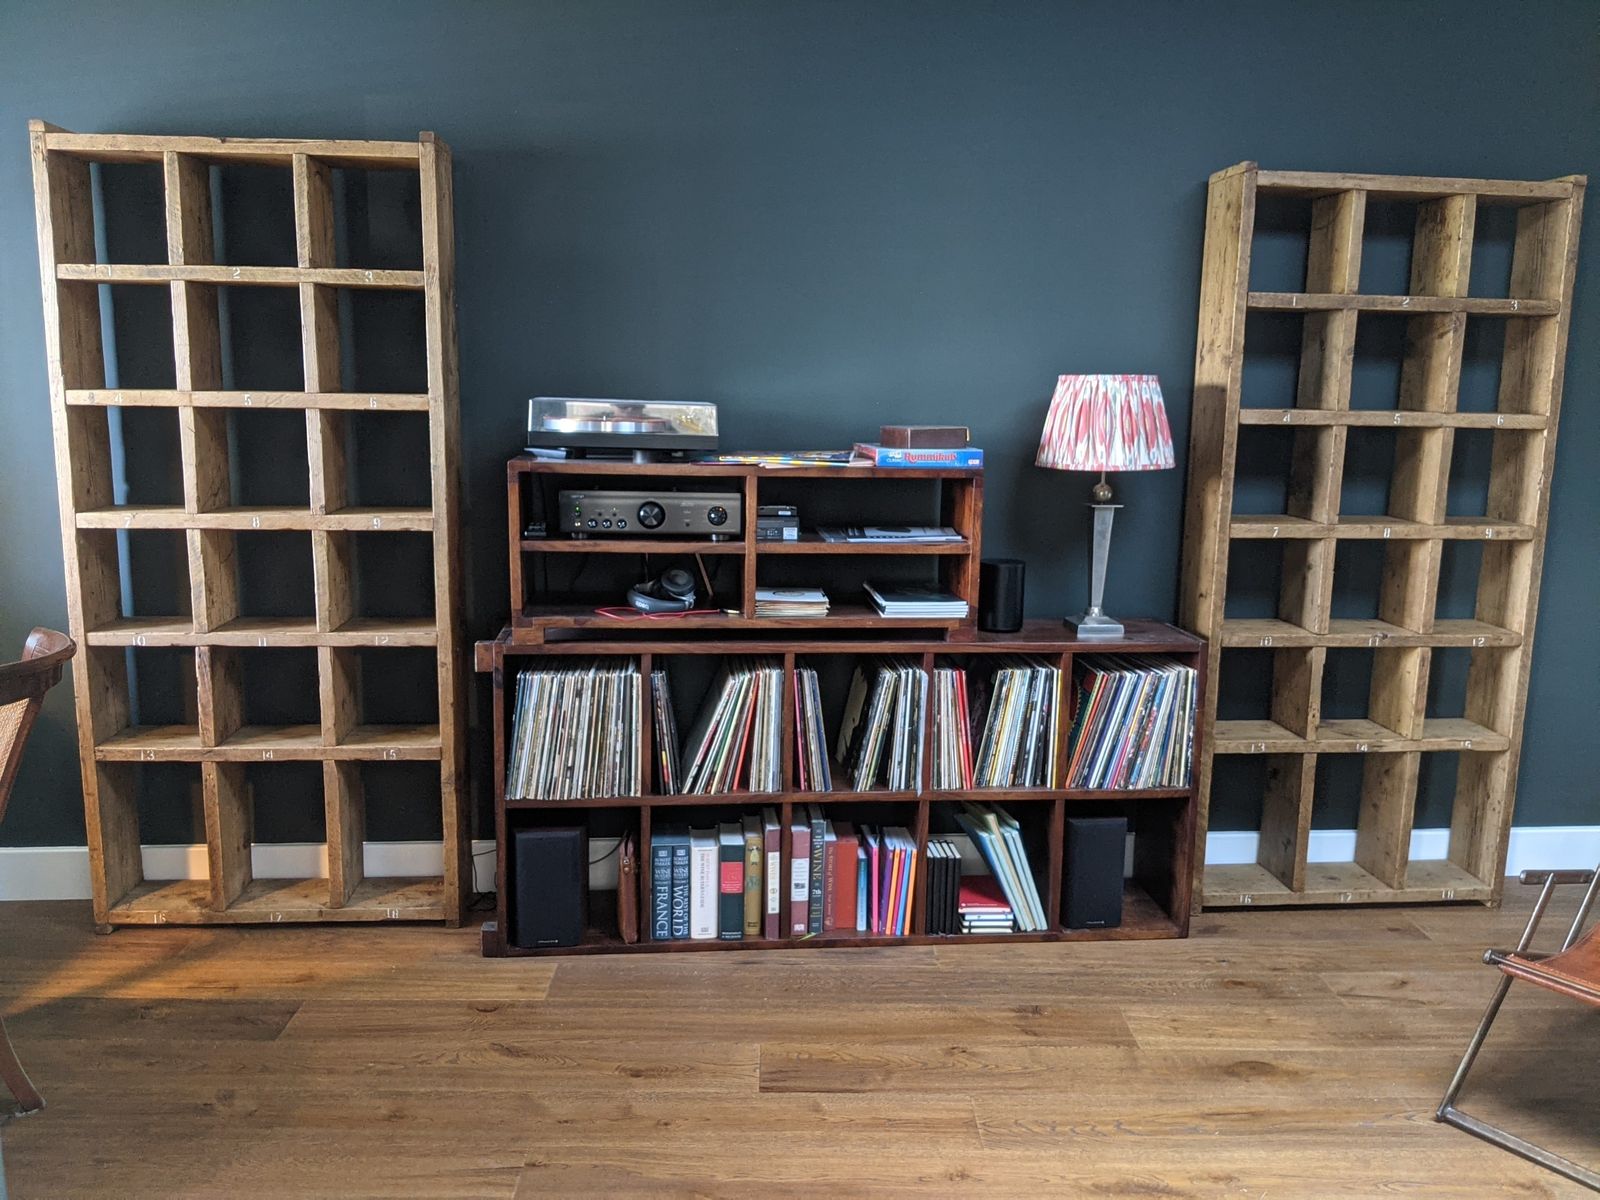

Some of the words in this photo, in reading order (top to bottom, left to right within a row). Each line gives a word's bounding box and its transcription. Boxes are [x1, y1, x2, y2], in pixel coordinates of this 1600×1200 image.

[232, 268, 240, 279] 2
[365, 271, 372, 282] 3
[1402, 297, 1410, 307] 2
[1511, 300, 1518, 311] 3
[114, 393, 122, 403] 4
[244, 394, 252, 406] 5
[1283, 413, 1290, 422] 4
[1394, 414, 1401, 425] 5
[1497, 415, 1504, 425] 6
[125, 517, 132, 528] 7
[252, 517, 260, 528] 8
[373, 517, 380, 529] 9
[1273, 527, 1279, 537] 7
[1384, 528, 1390, 538] 8
[1485, 528, 1492, 539] 9
[132, 636, 146, 646] 10
[258, 637, 266, 647] 11
[375, 636, 388, 644] 12
[1368, 637, 1379, 647] 11
[1472, 637, 1485, 647] 12
[1252, 743, 1265, 752] 13
[141, 750, 154, 760] 13
[262, 750, 272, 760] 14
[384, 750, 396, 760] 15
[813, 848, 823, 880] WINE
[1239, 894, 1252, 904] 16
[1341, 892, 1352, 902] 17
[1441, 889, 1454, 900] 18
[656, 886, 668, 936] FRANCE
[673, 885, 683, 936] WORLD
